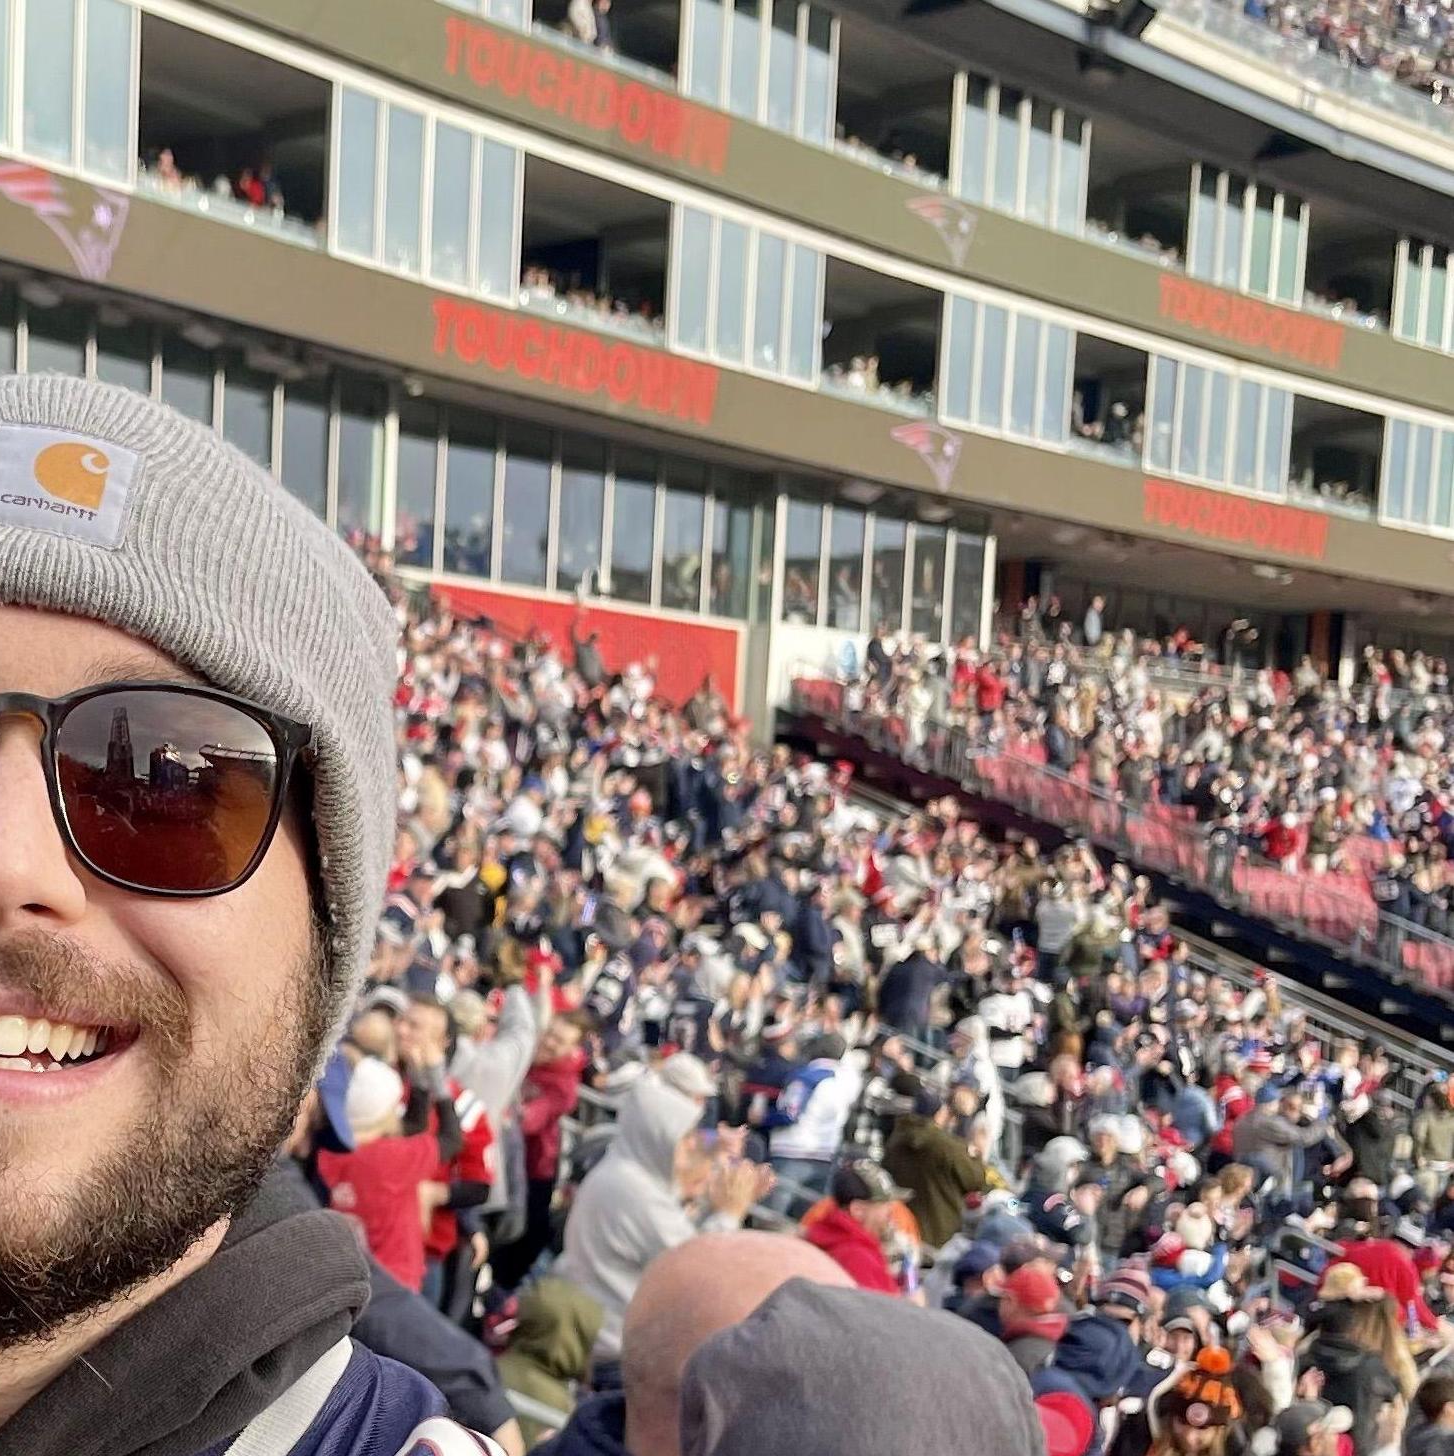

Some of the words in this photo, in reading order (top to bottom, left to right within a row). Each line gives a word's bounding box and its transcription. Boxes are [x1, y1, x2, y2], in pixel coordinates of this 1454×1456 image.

[445, 16, 731, 175] TOUCHDOWN
[433, 295, 719, 425] TOUCHDOWN
[1159, 273, 1345, 368] TOUCHDOWN
[0, 493, 98, 521] carhartt
[1143, 479, 1329, 560] TOUCHDOWN
